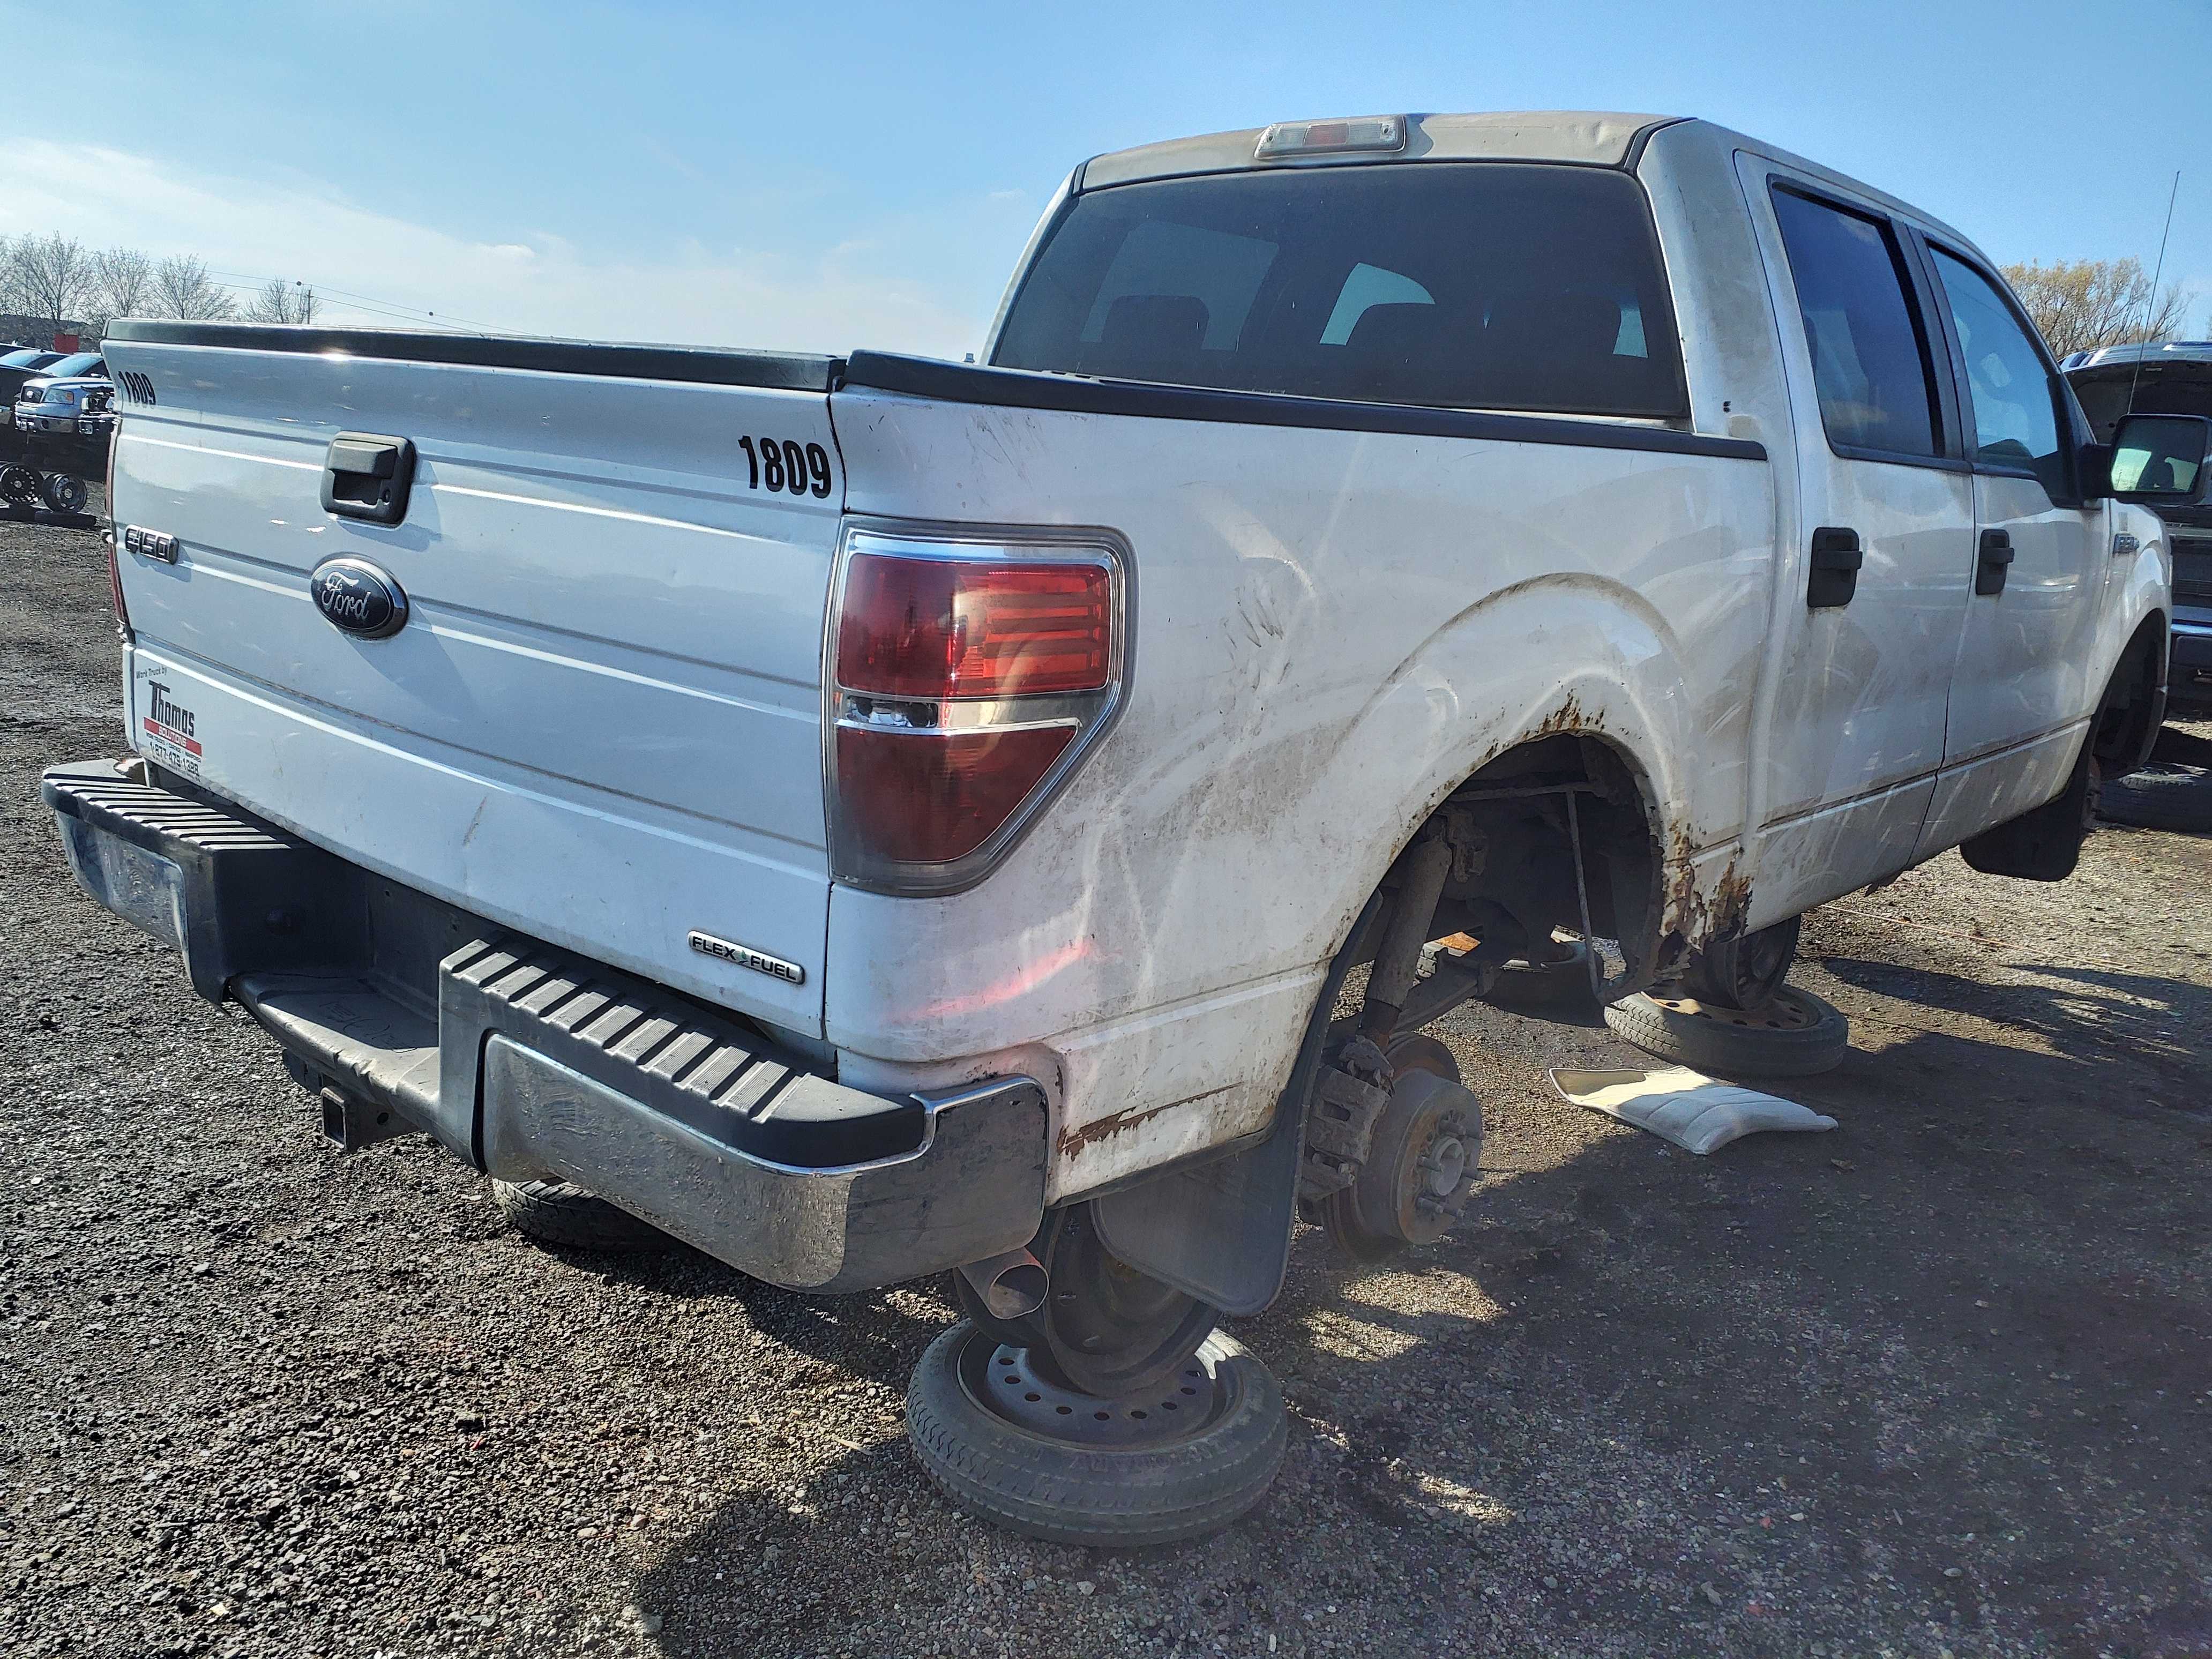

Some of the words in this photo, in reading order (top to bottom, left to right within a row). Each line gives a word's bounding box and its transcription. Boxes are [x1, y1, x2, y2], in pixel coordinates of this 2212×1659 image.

[118, 371, 156, 409] 1809
[738, 435, 831, 499] 1809
[322, 571, 371, 620] Ford
[136, 670, 148, 679] Work
[148, 667, 161, 677] Truck
[162, 664, 168, 676] by
[148, 679, 195, 737] Thomas
[159, 726, 187, 747] SOLUTIONS
[692, 936, 736, 960] FLEX
[750, 955, 796, 981] FUEL
